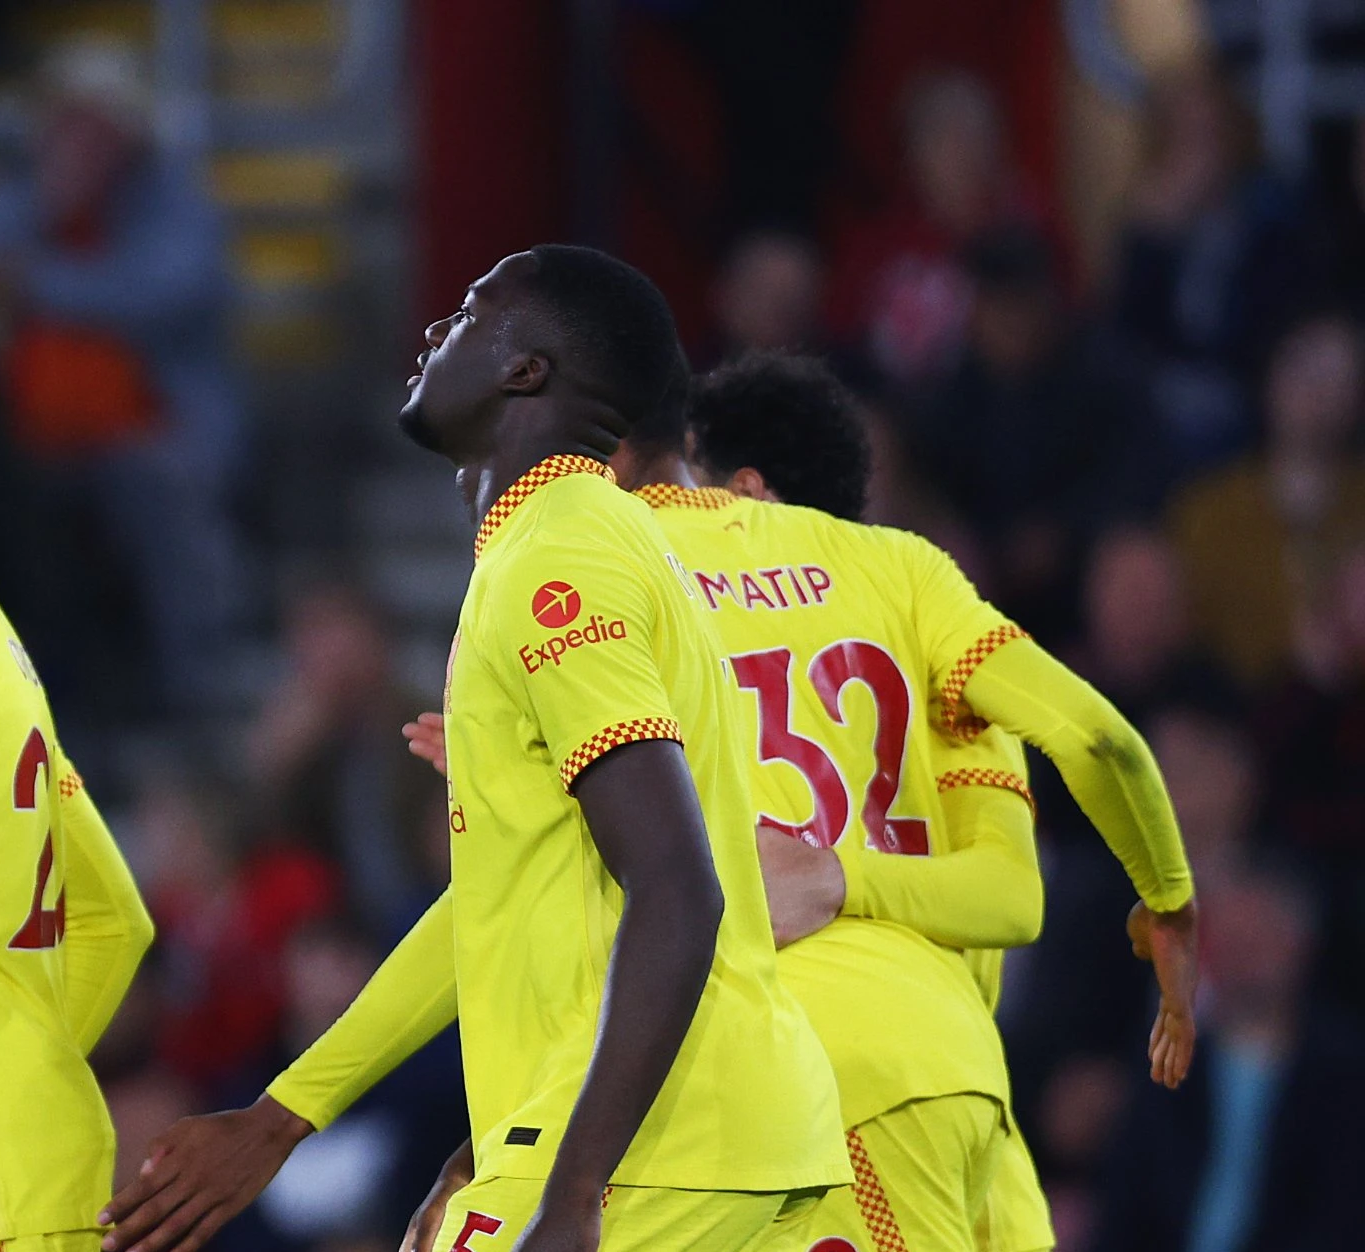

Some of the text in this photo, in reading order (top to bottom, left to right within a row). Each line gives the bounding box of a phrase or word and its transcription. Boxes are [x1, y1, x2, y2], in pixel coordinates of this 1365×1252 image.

[692, 565, 832, 610] MATIP
[518, 615, 627, 675] Expedia
[728, 638, 931, 857] 32
